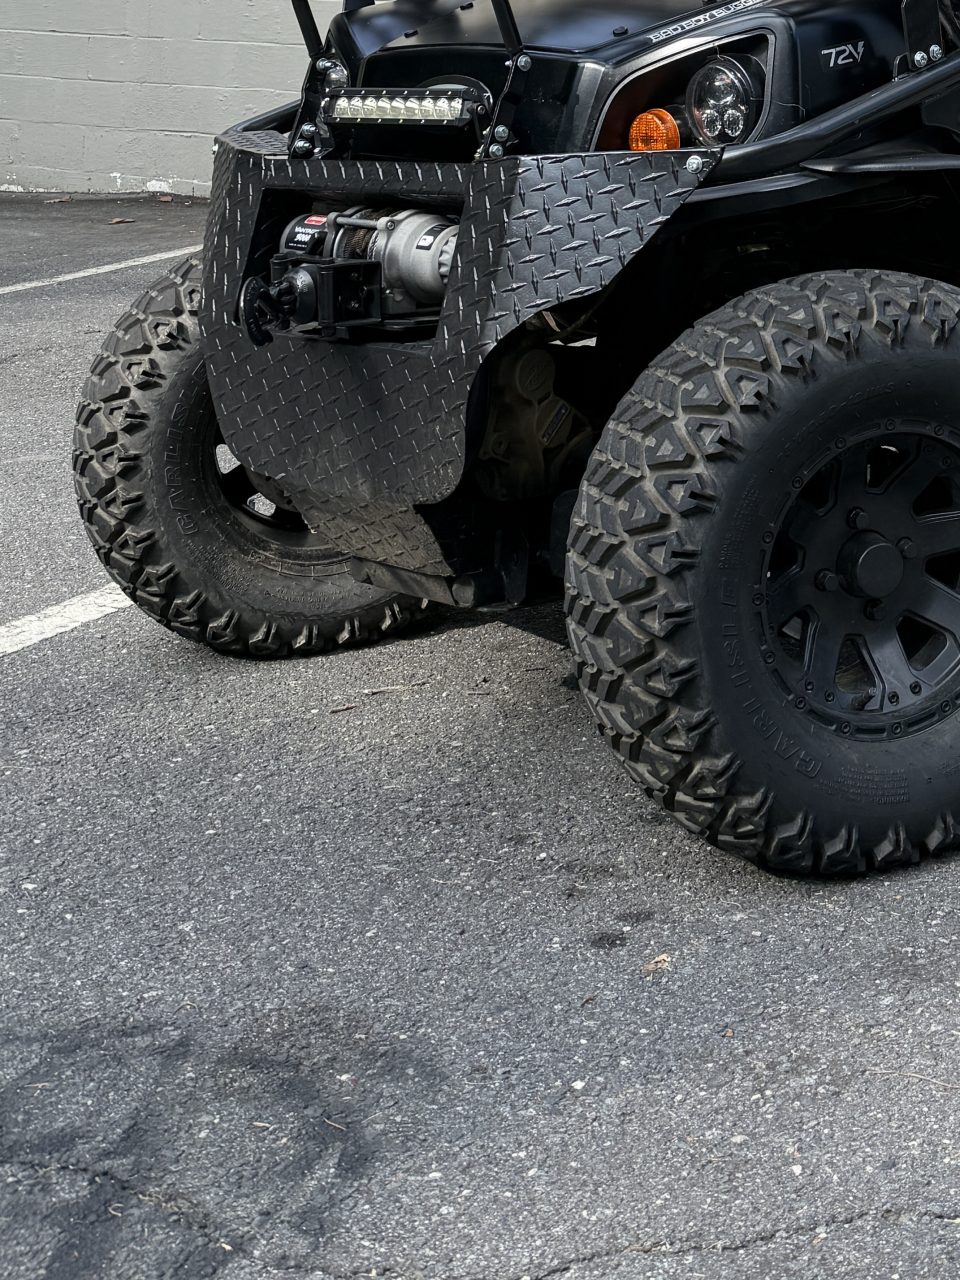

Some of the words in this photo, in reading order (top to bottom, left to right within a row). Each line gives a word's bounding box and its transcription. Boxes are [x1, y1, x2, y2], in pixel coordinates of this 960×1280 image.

[649, 27, 682, 43] BAD
[680, 14, 713, 33] BOY
[821, 41, 864, 67] 72V
